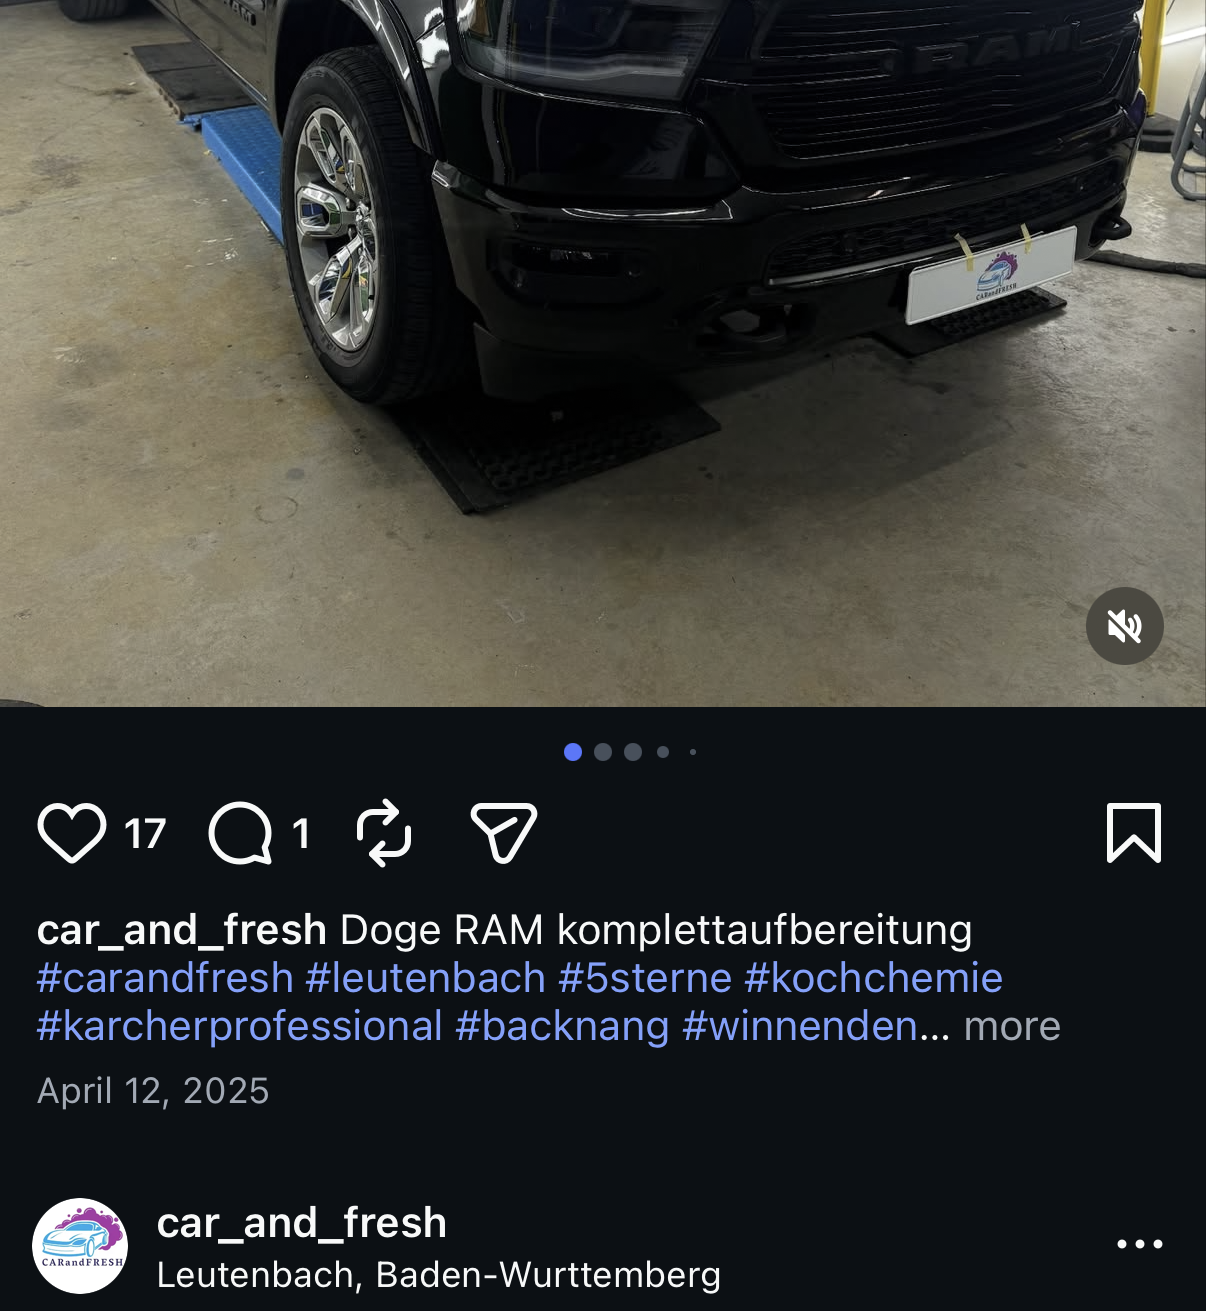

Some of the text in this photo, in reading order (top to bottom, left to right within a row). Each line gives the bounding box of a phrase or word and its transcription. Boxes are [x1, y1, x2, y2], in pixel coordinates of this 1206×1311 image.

[911, 24, 1076, 74] RAM
[125, 818, 166, 848] 17
[293, 818, 307, 848] 1
[38, 912, 971, 952] car_and_fresh Doge RAM komplettaufbereitung
[36, 961, 1002, 993] #carandfresh #leutenbach #5sterne #kochchemie
[36, 1009, 440, 1048] #karcherprofessional
[455, 1009, 668, 1048] #backnang
[966, 1017, 1060, 1041] more
[37, 1076, 268, 1110] April 12, 2025
[158, 1205, 445, 1244] car_and_fresh
[42, 1258, 123, 1267] CARandFRESH
[159, 1260, 719, 1294] Leutenbach, Baden-Wurttemberg
